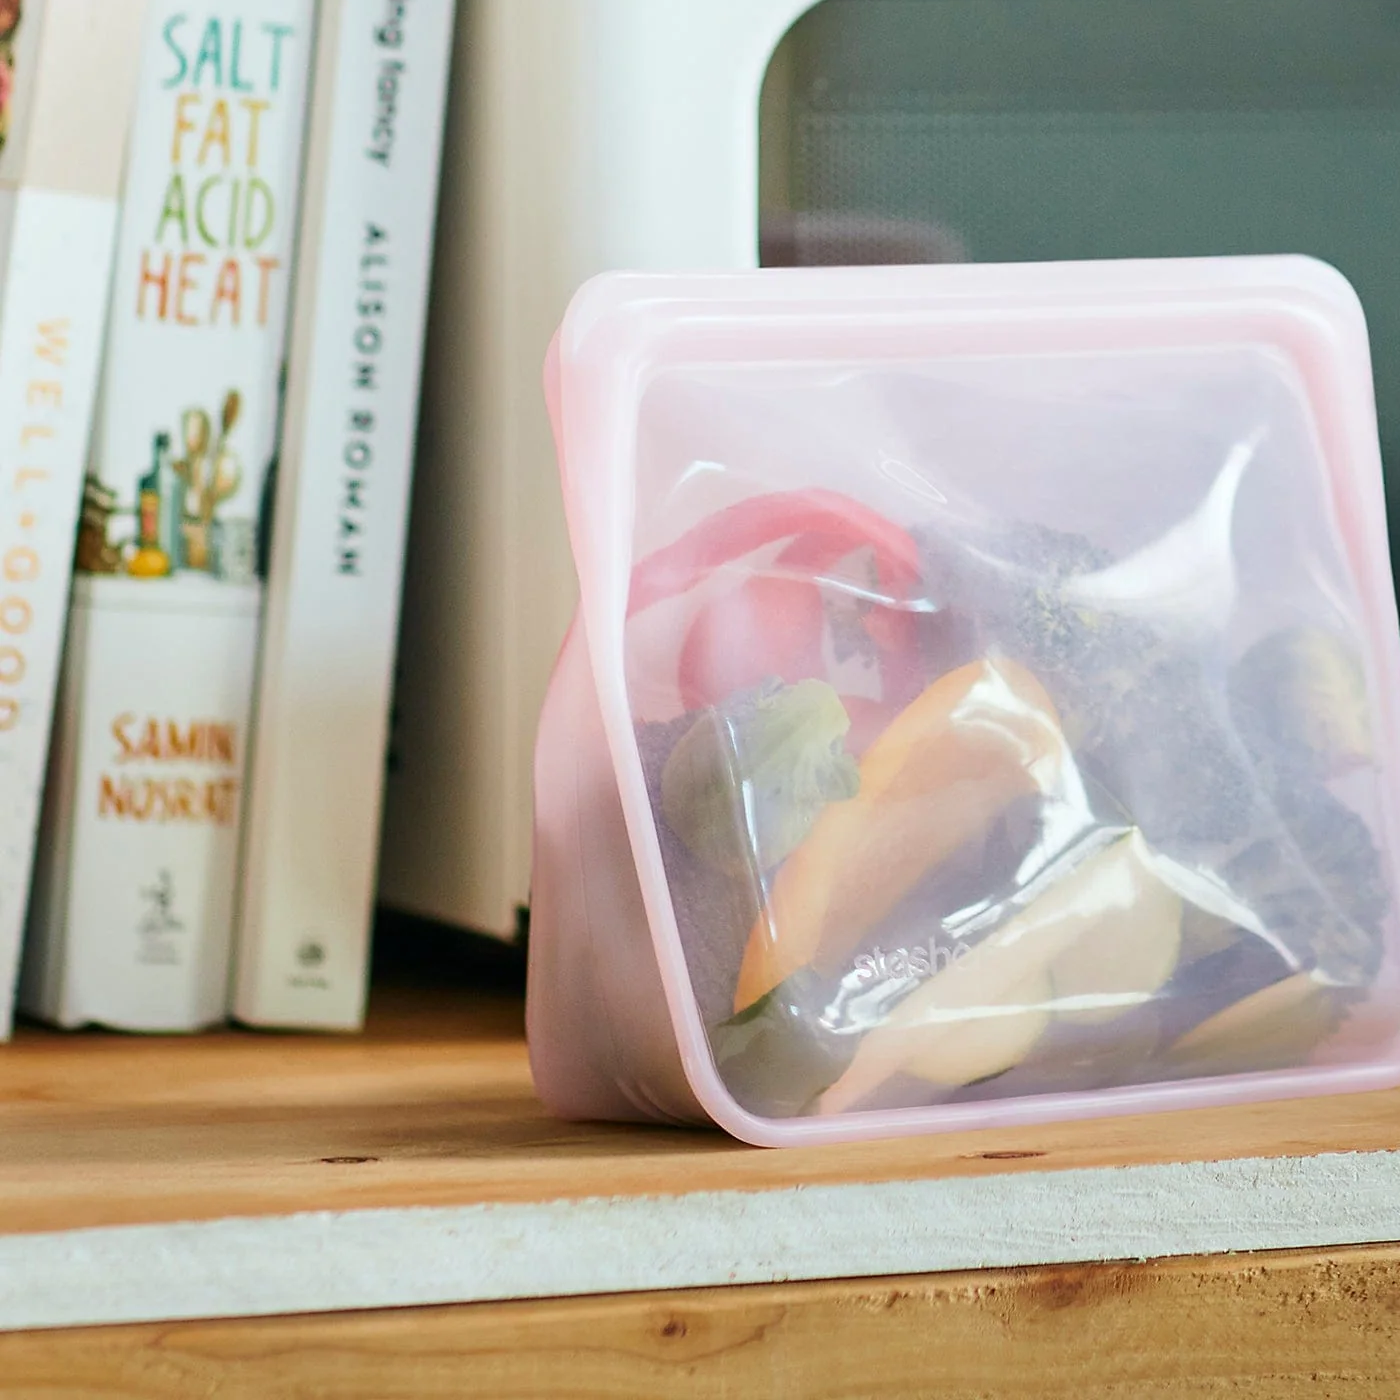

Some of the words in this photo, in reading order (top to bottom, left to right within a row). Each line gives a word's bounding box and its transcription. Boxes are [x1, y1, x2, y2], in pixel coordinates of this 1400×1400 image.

[162, 11, 296, 92] SALT
[170, 93, 272, 167] FAT
[364, 59, 406, 168] fancy
[154, 173, 275, 250] ACID
[136, 251, 280, 326] HEAT
[352, 219, 389, 391] ALISON
[334, 408, 377, 576] ROMAN
[110, 711, 237, 767] SAMIN
